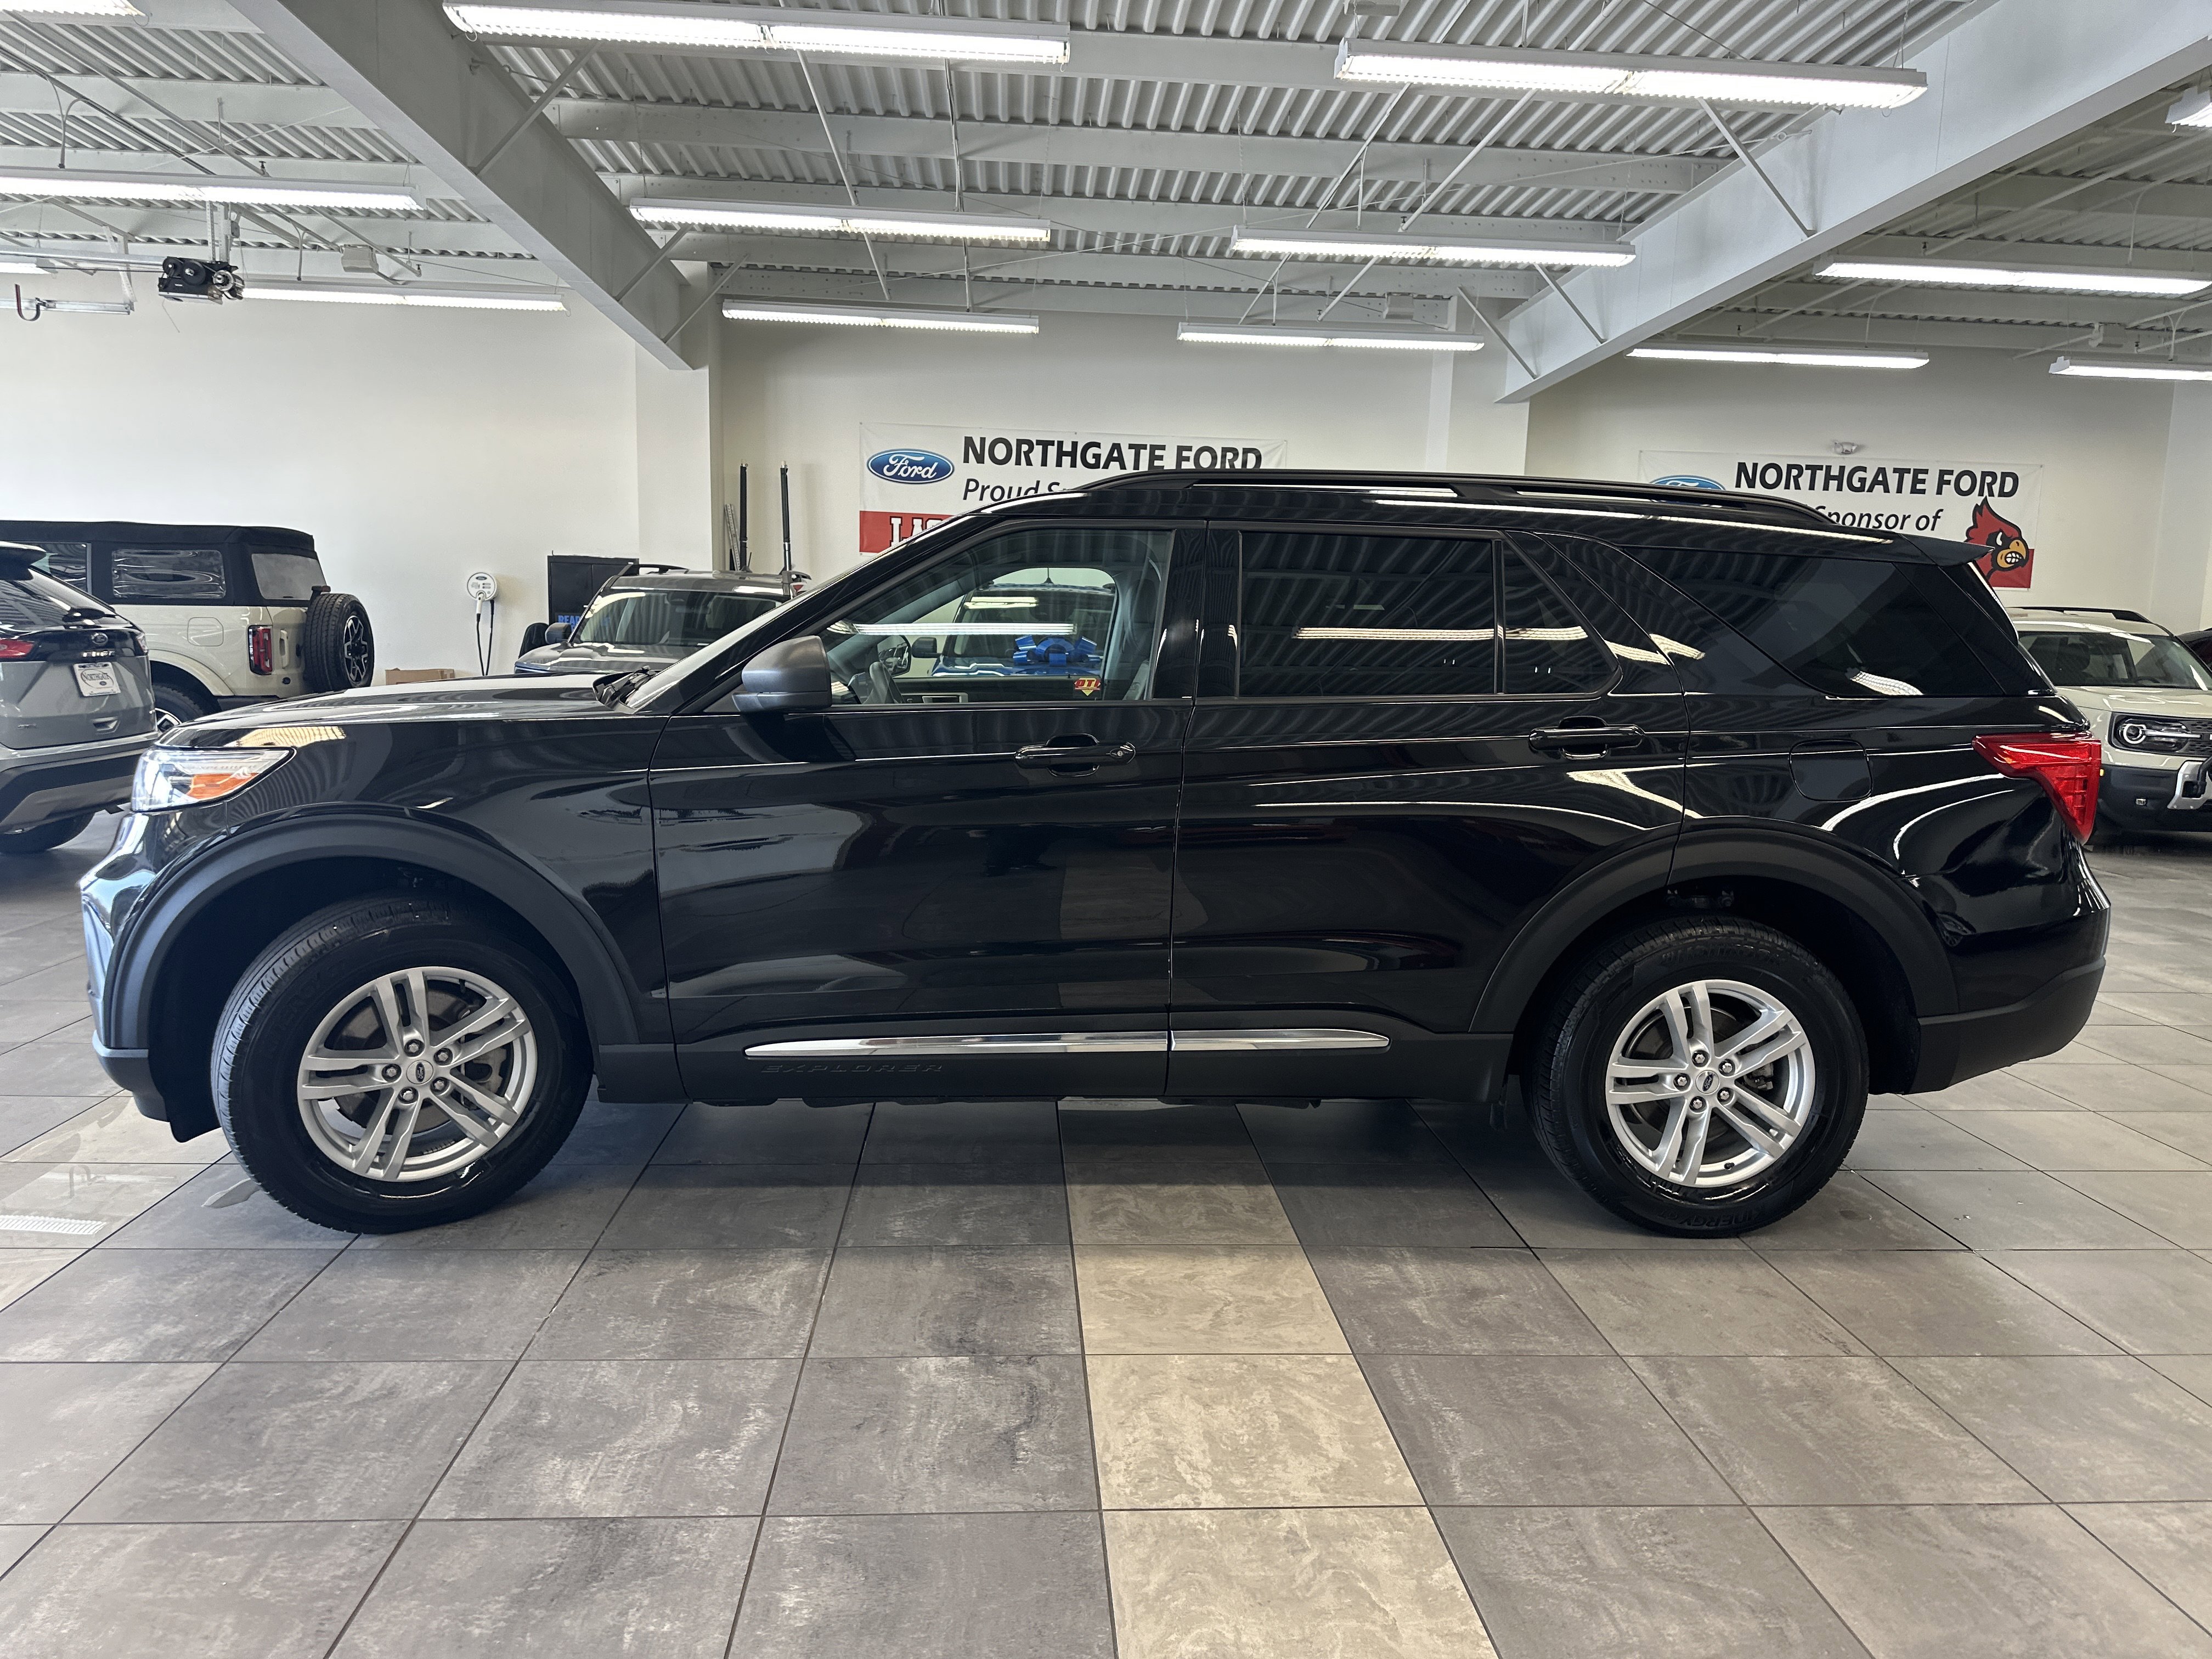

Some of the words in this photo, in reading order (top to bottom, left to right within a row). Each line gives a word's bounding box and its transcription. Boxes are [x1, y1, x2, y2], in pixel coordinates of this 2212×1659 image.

[883, 453, 939, 479] Ford
[962, 436, 1166, 471] NORTHGATE
[1176, 444, 1262, 469] FORD
[963, 478, 1041, 502] Proud
[1735, 462, 1929, 495] NORTHGATE
[1936, 469, 2019, 498] FORD
[1915, 509, 1944, 531] of
[761, 1064, 942, 1073] EXPLORER
